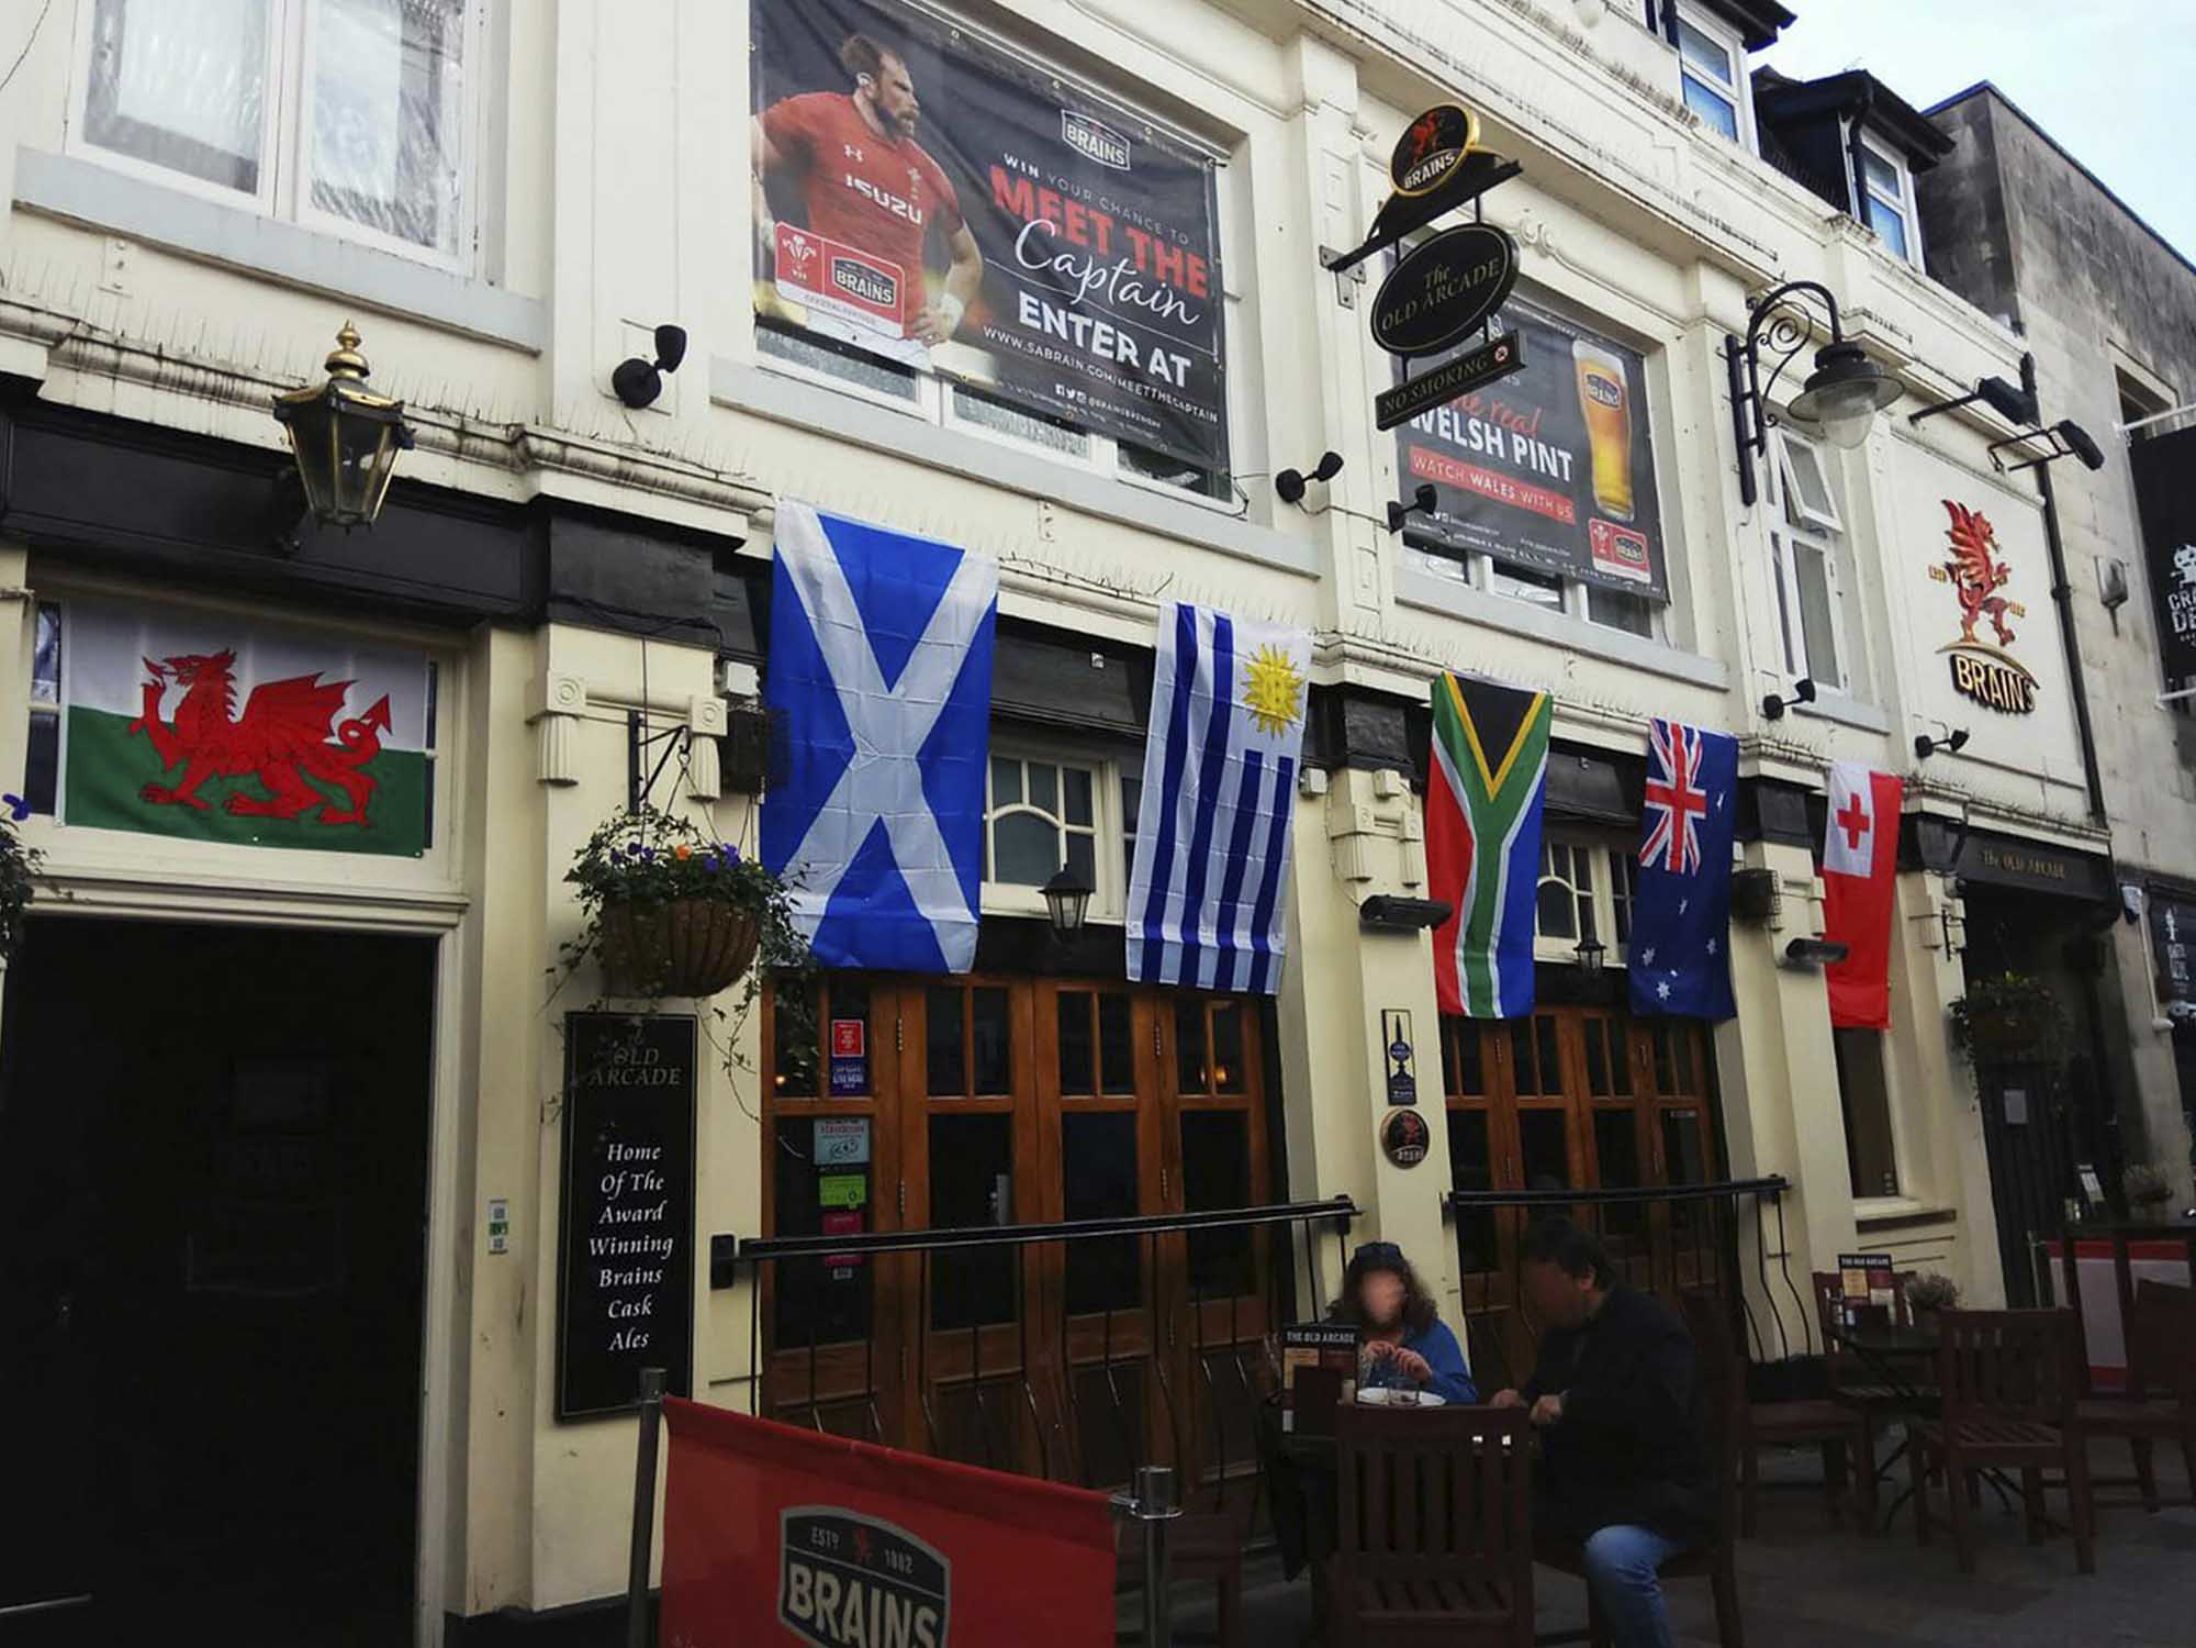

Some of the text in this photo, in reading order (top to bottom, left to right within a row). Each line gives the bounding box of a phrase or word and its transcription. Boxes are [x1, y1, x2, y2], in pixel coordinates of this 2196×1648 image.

[1067, 123, 1125, 165] BRAINS
[1404, 151, 1456, 190] BRAINS
[846, 173, 922, 225] ISUZU
[1004, 153, 1189, 245] WIN YOUR CHANCE TO
[990, 164, 1209, 299] MEET THE
[836, 269, 893, 303] BRAINS
[1015, 219, 1200, 325] Captain
[1424, 264, 1450, 289] The
[1382, 257, 1500, 331] OLD ARCADE
[1019, 290, 1192, 388] ENTER AT
[1384, 355, 1489, 414] NO SMOKING
[1410, 406, 1573, 482] WELSH PINT
[1412, 454, 1464, 480] WATCH
[1470, 473, 1516, 499] WALES
[1520, 491, 1554, 511] WITH
[1953, 655, 2036, 713] BRAINS
[612, 1046, 660, 1066] OLD
[588, 1067, 683, 1086] ARCADE
[607, 1143, 662, 1161] Home
[601, 1169, 665, 1200] Of The
[599, 1200, 668, 1224] Award
[589, 1234, 674, 1260] Winning
[599, 1267, 663, 1288] Brains
[607, 1293, 653, 1319] Cask
[608, 1327, 650, 1351] Ales
[1286, 1330, 1303, 1343] THE
[787, 1561, 939, 1648] BRAINS
